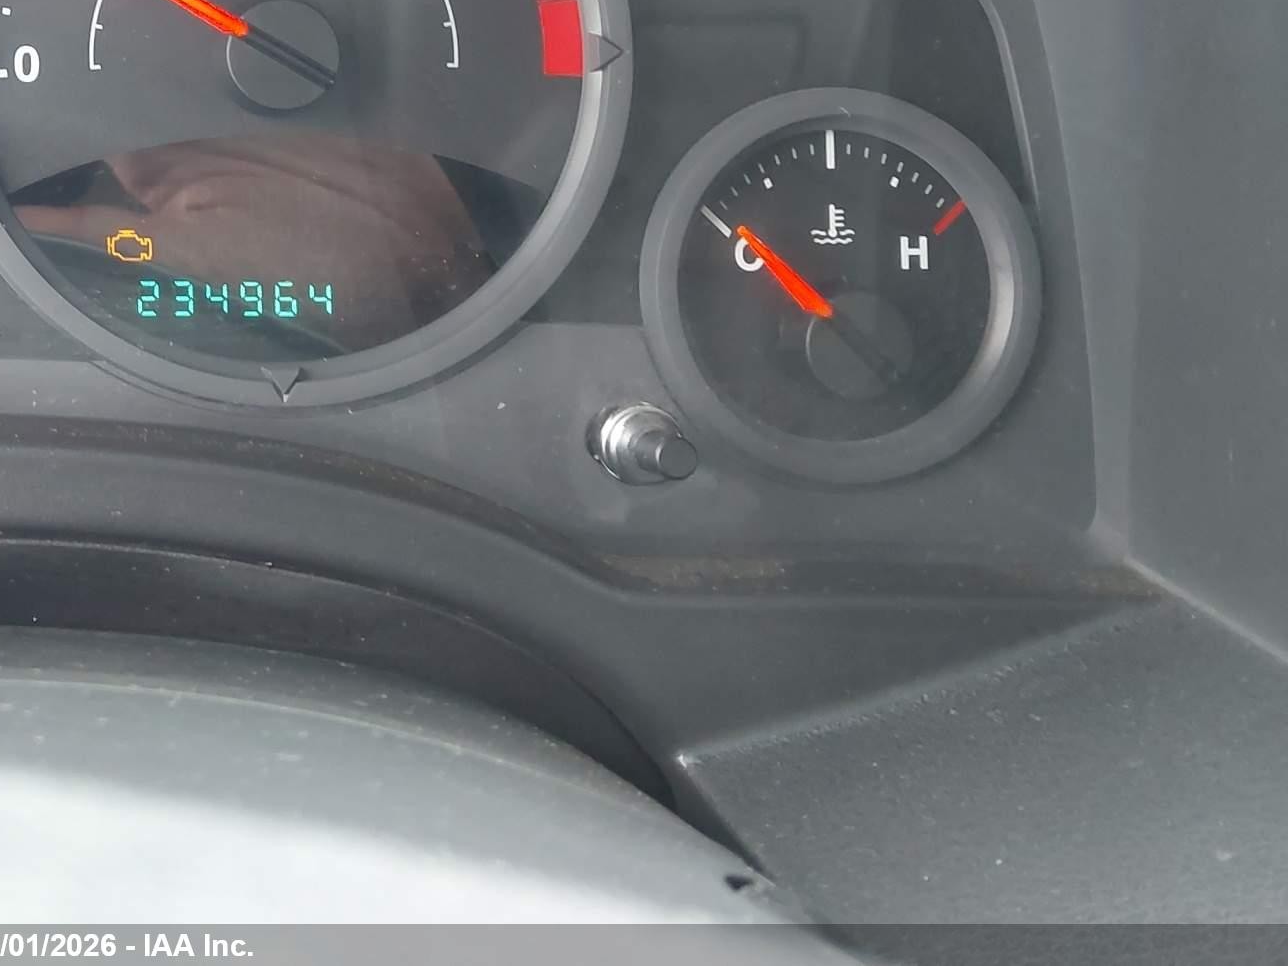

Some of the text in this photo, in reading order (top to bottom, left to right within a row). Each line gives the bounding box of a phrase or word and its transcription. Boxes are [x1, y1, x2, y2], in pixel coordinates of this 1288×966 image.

[13, 46, 41, 83] 0
[733, 237, 765, 272] C
[899, 235, 930, 271] H
[136, 279, 334, 318] 234964
